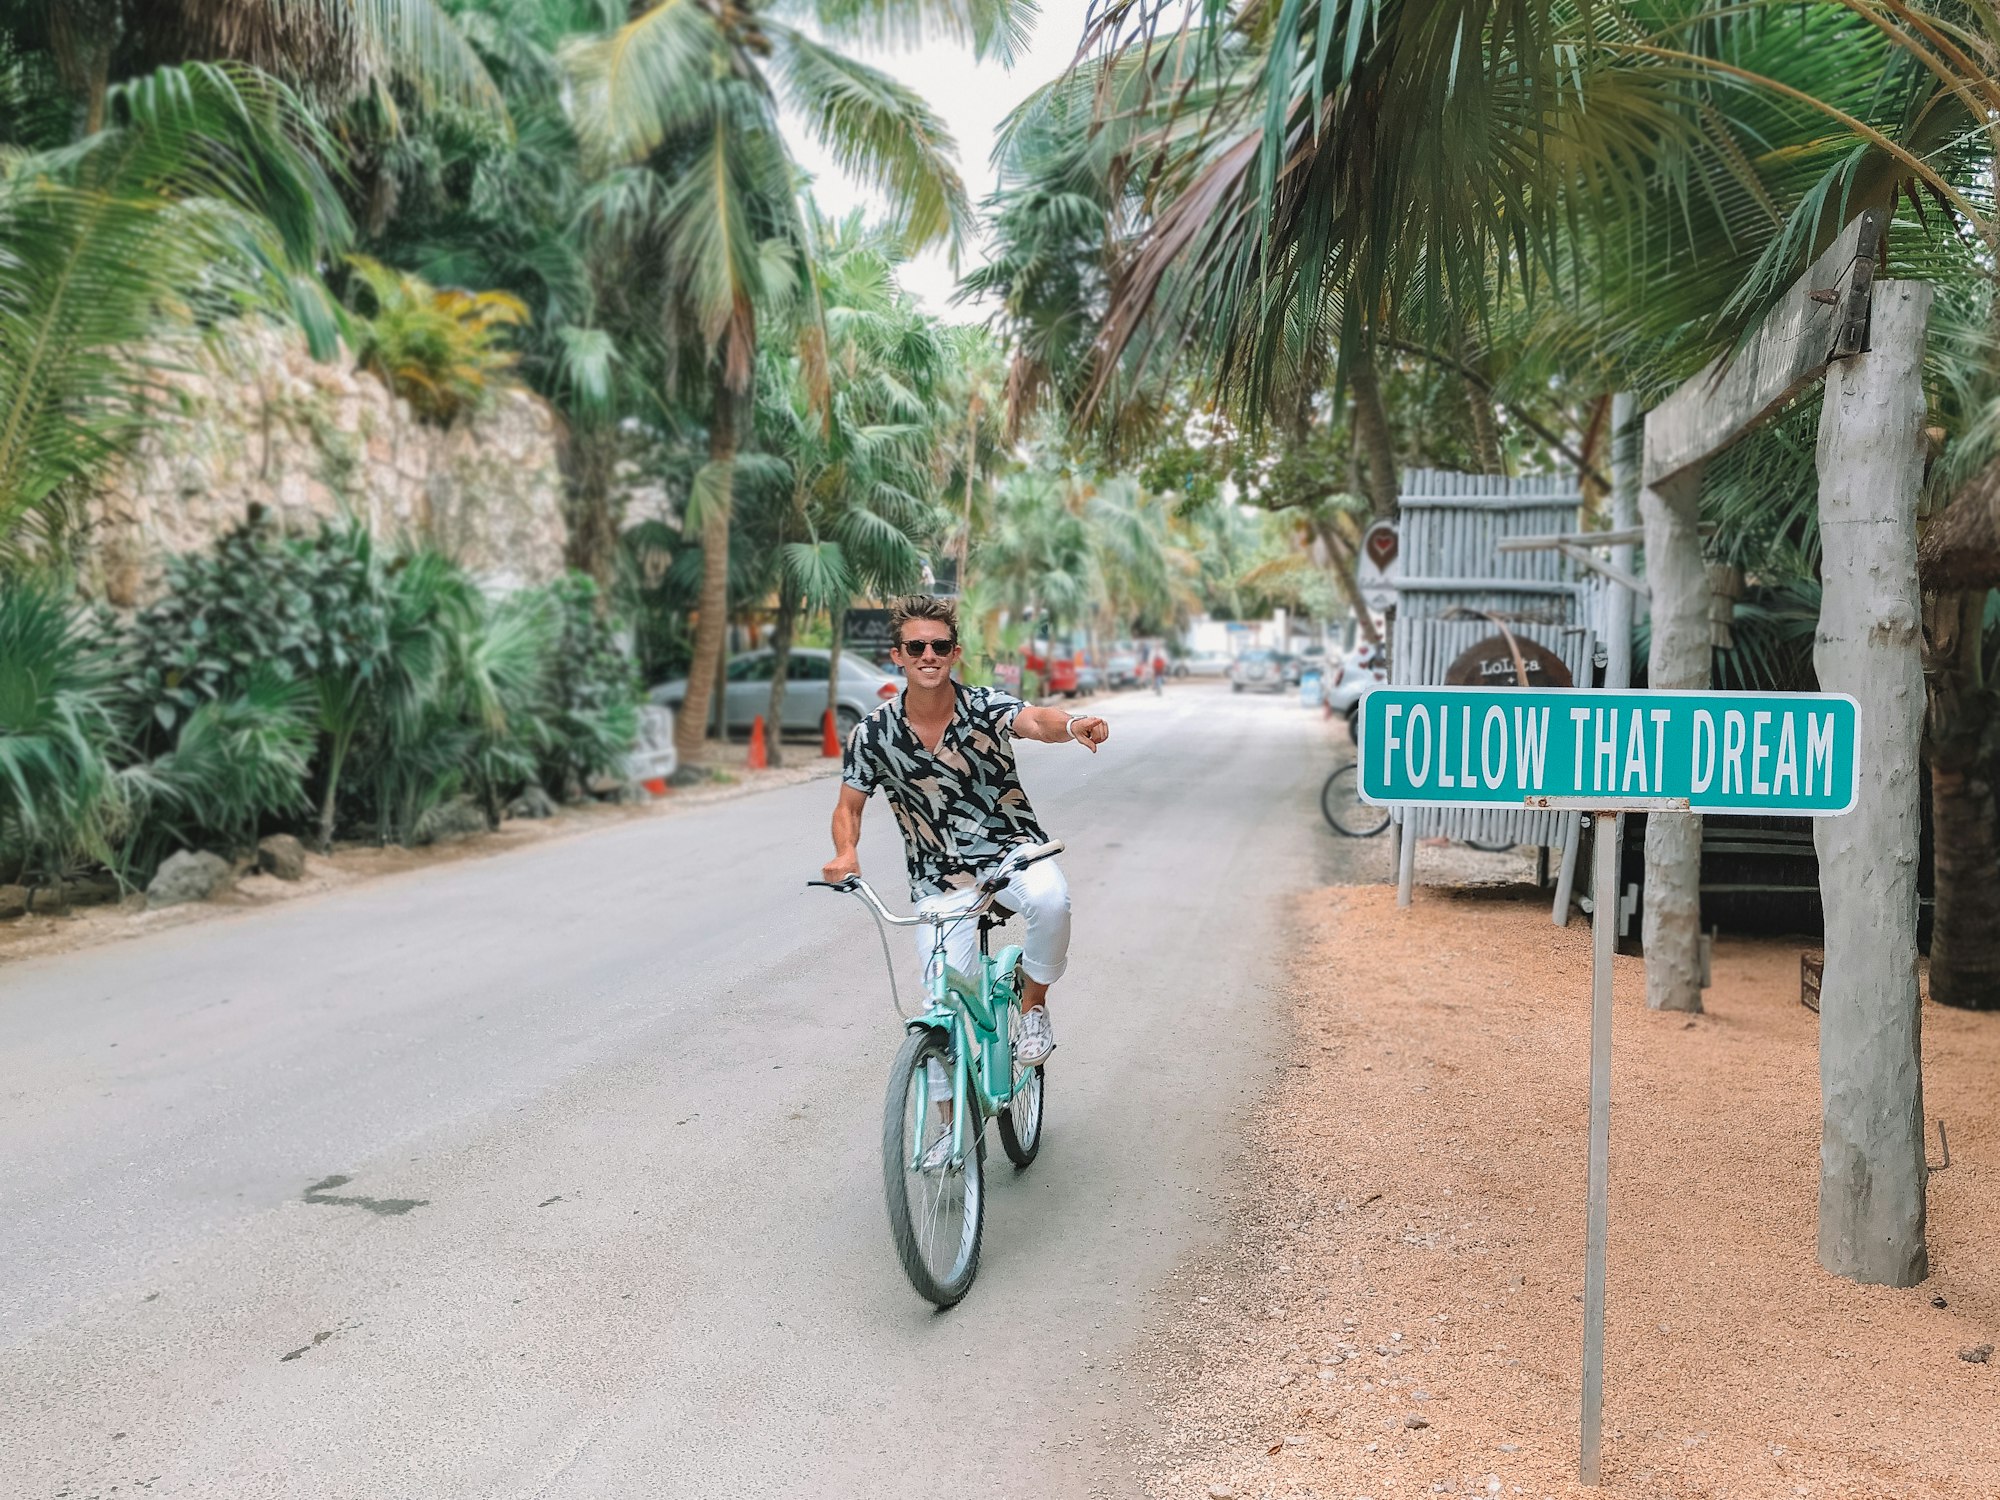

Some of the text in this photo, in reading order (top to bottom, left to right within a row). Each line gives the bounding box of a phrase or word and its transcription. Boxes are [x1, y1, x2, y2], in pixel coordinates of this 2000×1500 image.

[1480, 657, 1541, 676] LoLta
[1384, 704, 1835, 797] FOLLOW THAT DREAM
